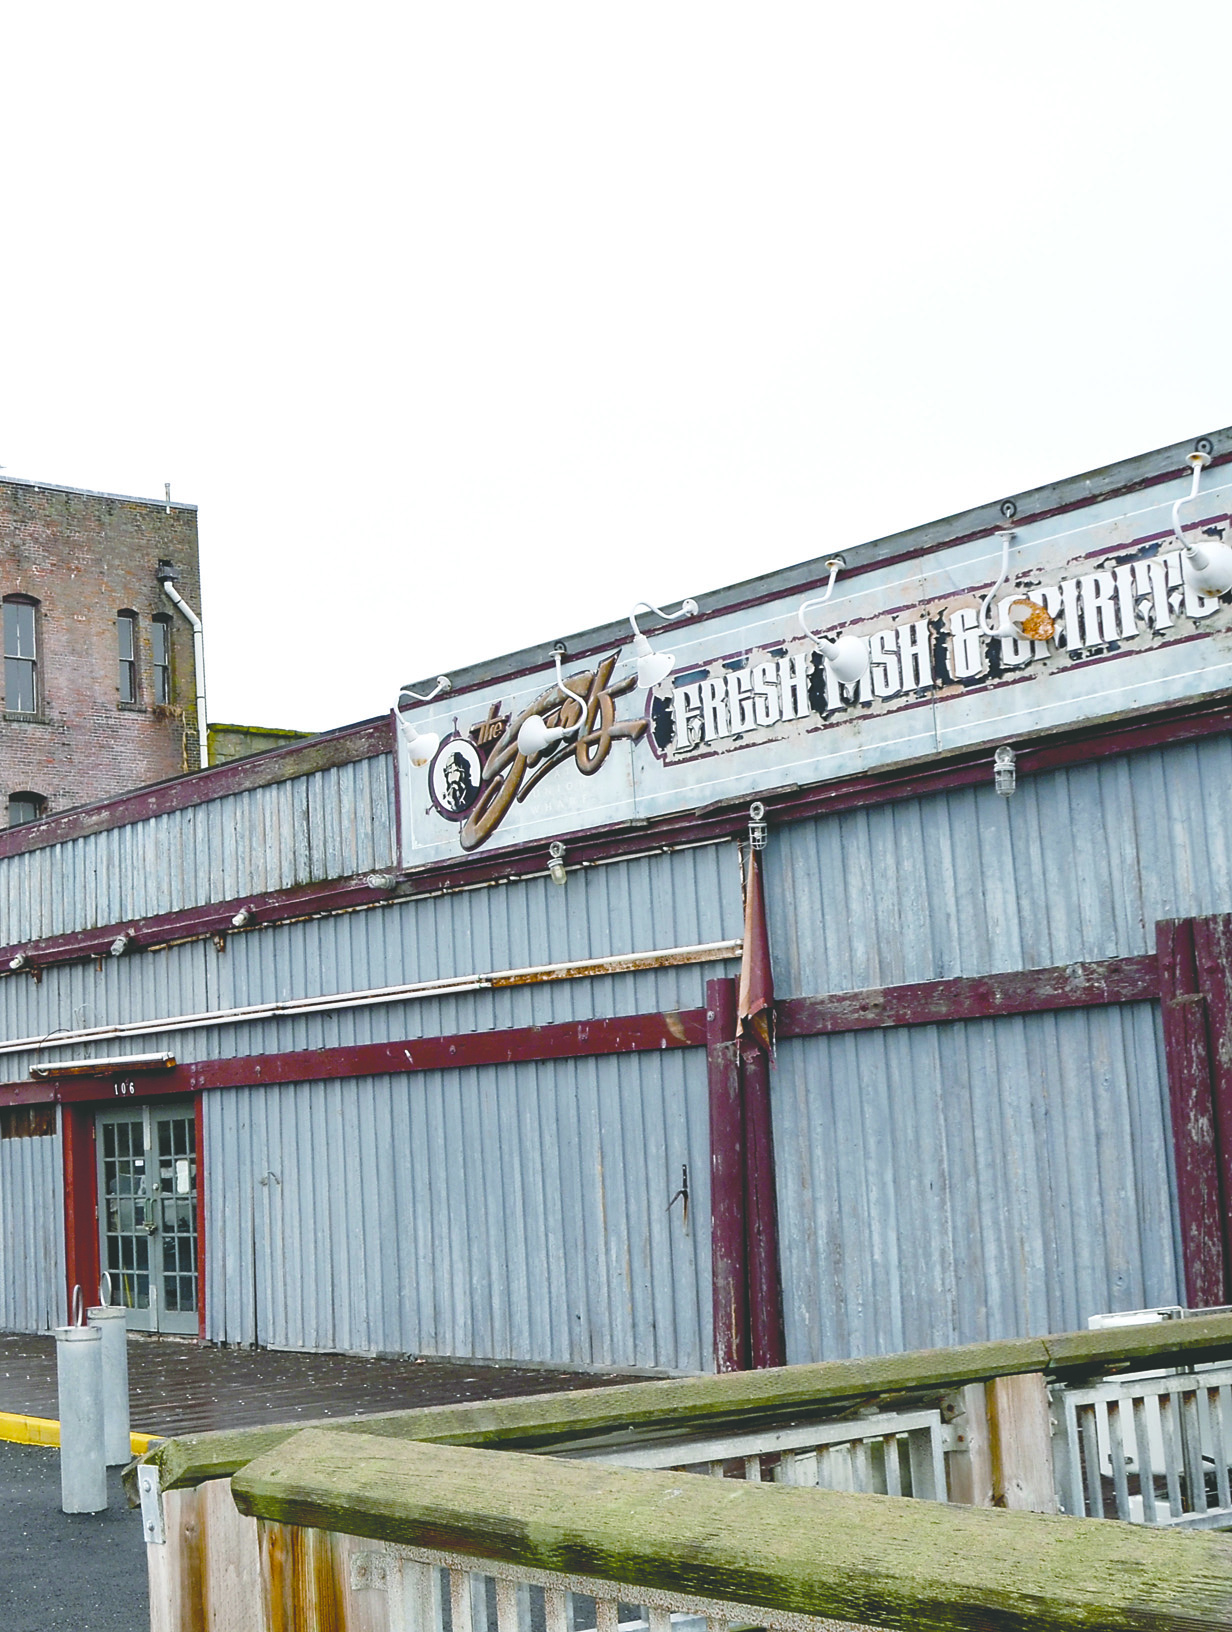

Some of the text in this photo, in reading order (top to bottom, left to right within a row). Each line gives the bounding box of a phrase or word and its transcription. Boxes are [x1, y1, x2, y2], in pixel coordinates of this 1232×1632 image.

[672, 652, 810, 748] FRESH
[950, 608, 984, 678] &
[471, 702, 507, 744] The
[114, 1082, 135, 1095] 106
